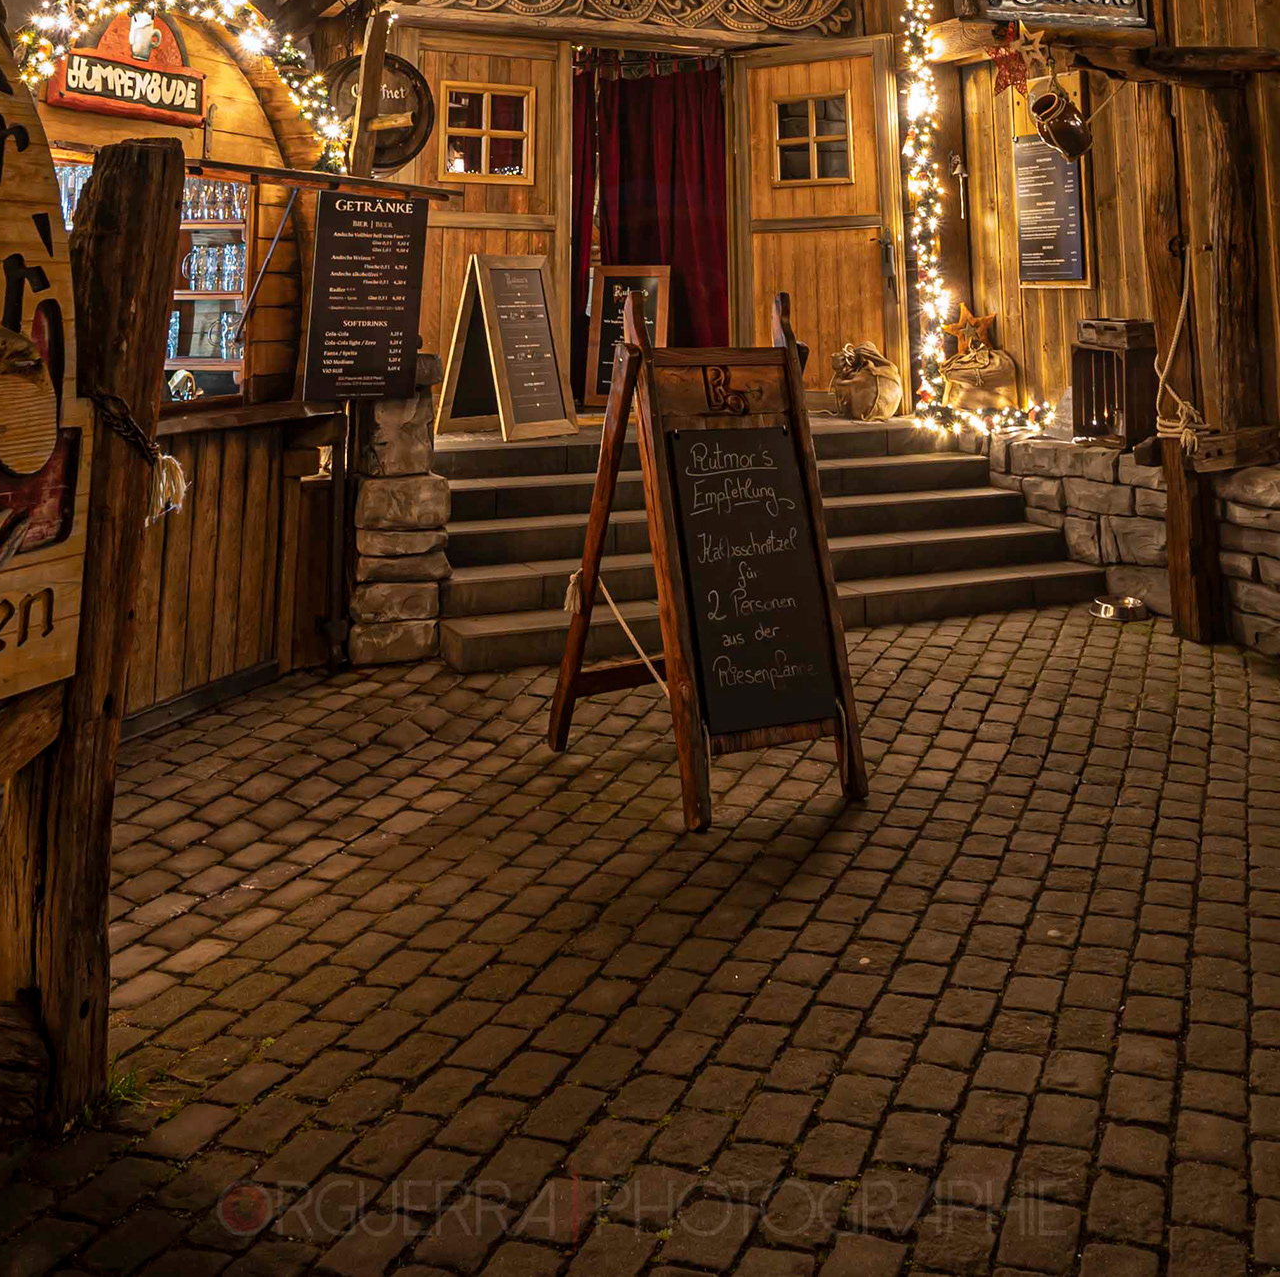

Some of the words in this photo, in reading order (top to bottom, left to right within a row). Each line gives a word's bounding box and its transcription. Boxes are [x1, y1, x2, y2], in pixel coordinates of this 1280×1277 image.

[67, 55, 197, 108] HUMPENBUDE
[335, 199, 413, 214] GETRÄNKE
[343, 320, 388, 328] SOFTDRINKS
[690, 442, 774, 471] Rutmor's
[693, 477, 779, 517] Empfehlung
[738, 561, 757, 589] für
[707, 590, 727, 620] 2
[730, 588, 797, 617] Personen
[722, 633, 745, 647] aus
[755, 623, 780, 641] der
[712, 650, 817, 689] Riesenpfanne
